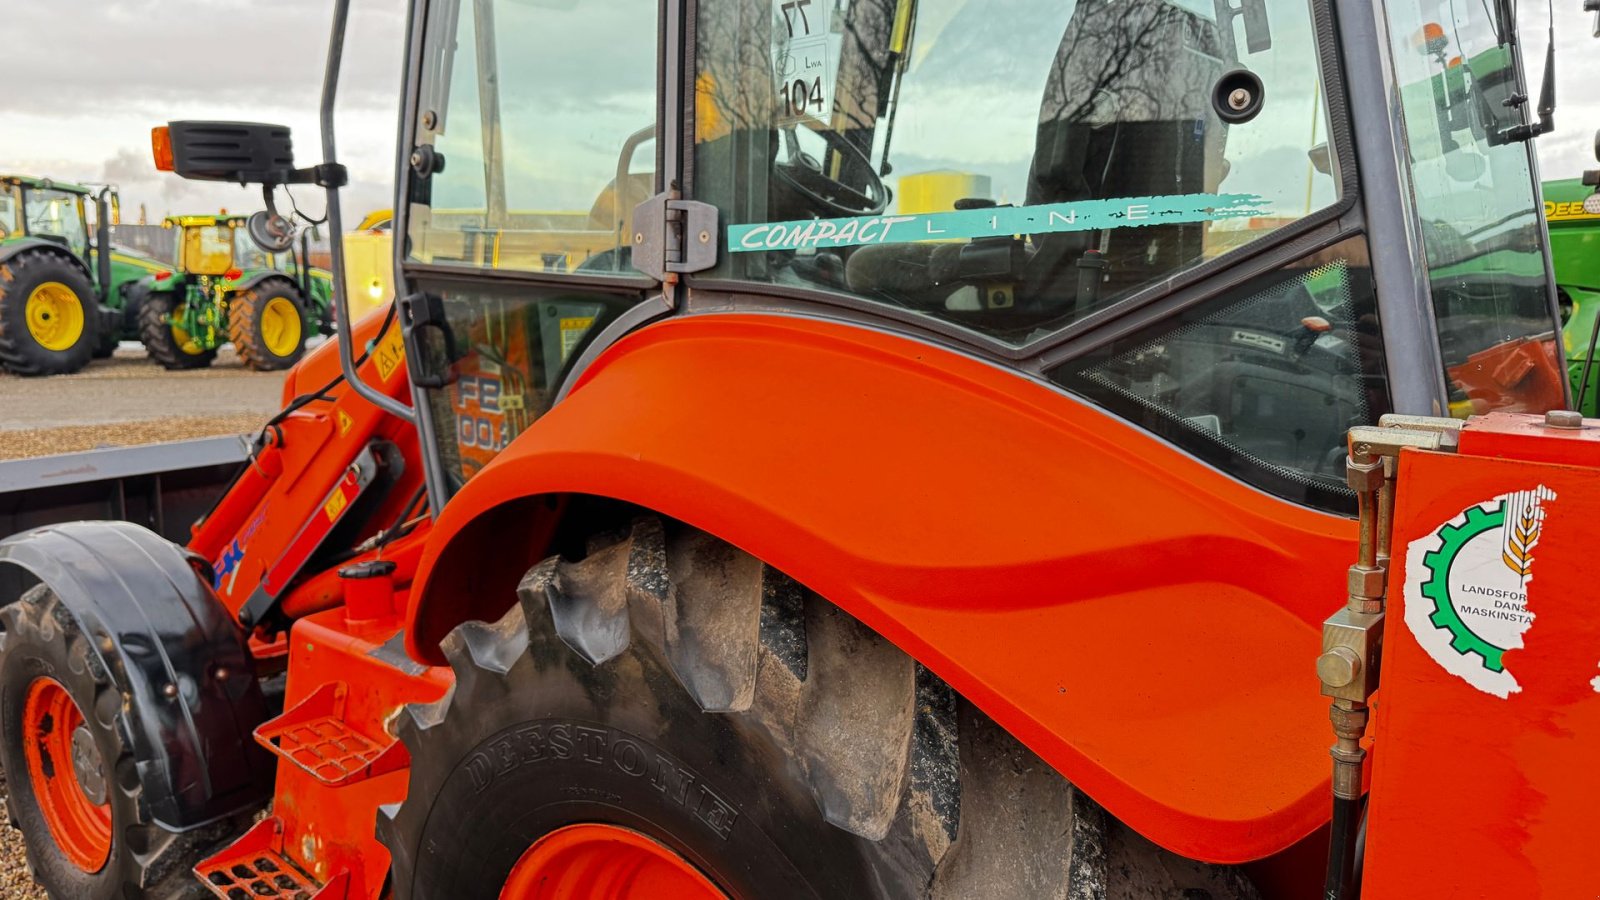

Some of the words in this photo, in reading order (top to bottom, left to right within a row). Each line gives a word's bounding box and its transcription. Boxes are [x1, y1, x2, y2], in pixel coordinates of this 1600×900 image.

[780, 76, 824, 117] 104
[1543, 201, 1588, 217] DEE
[741, 216, 917, 248] COMPACT
[927, 205, 1149, 233] LINE
[1461, 584, 1527, 602] LANDSFOR
[1460, 605, 1533, 624] MASKINSTA
[1494, 600, 1530, 613] DANS
[466, 723, 739, 841] DEESTONE
